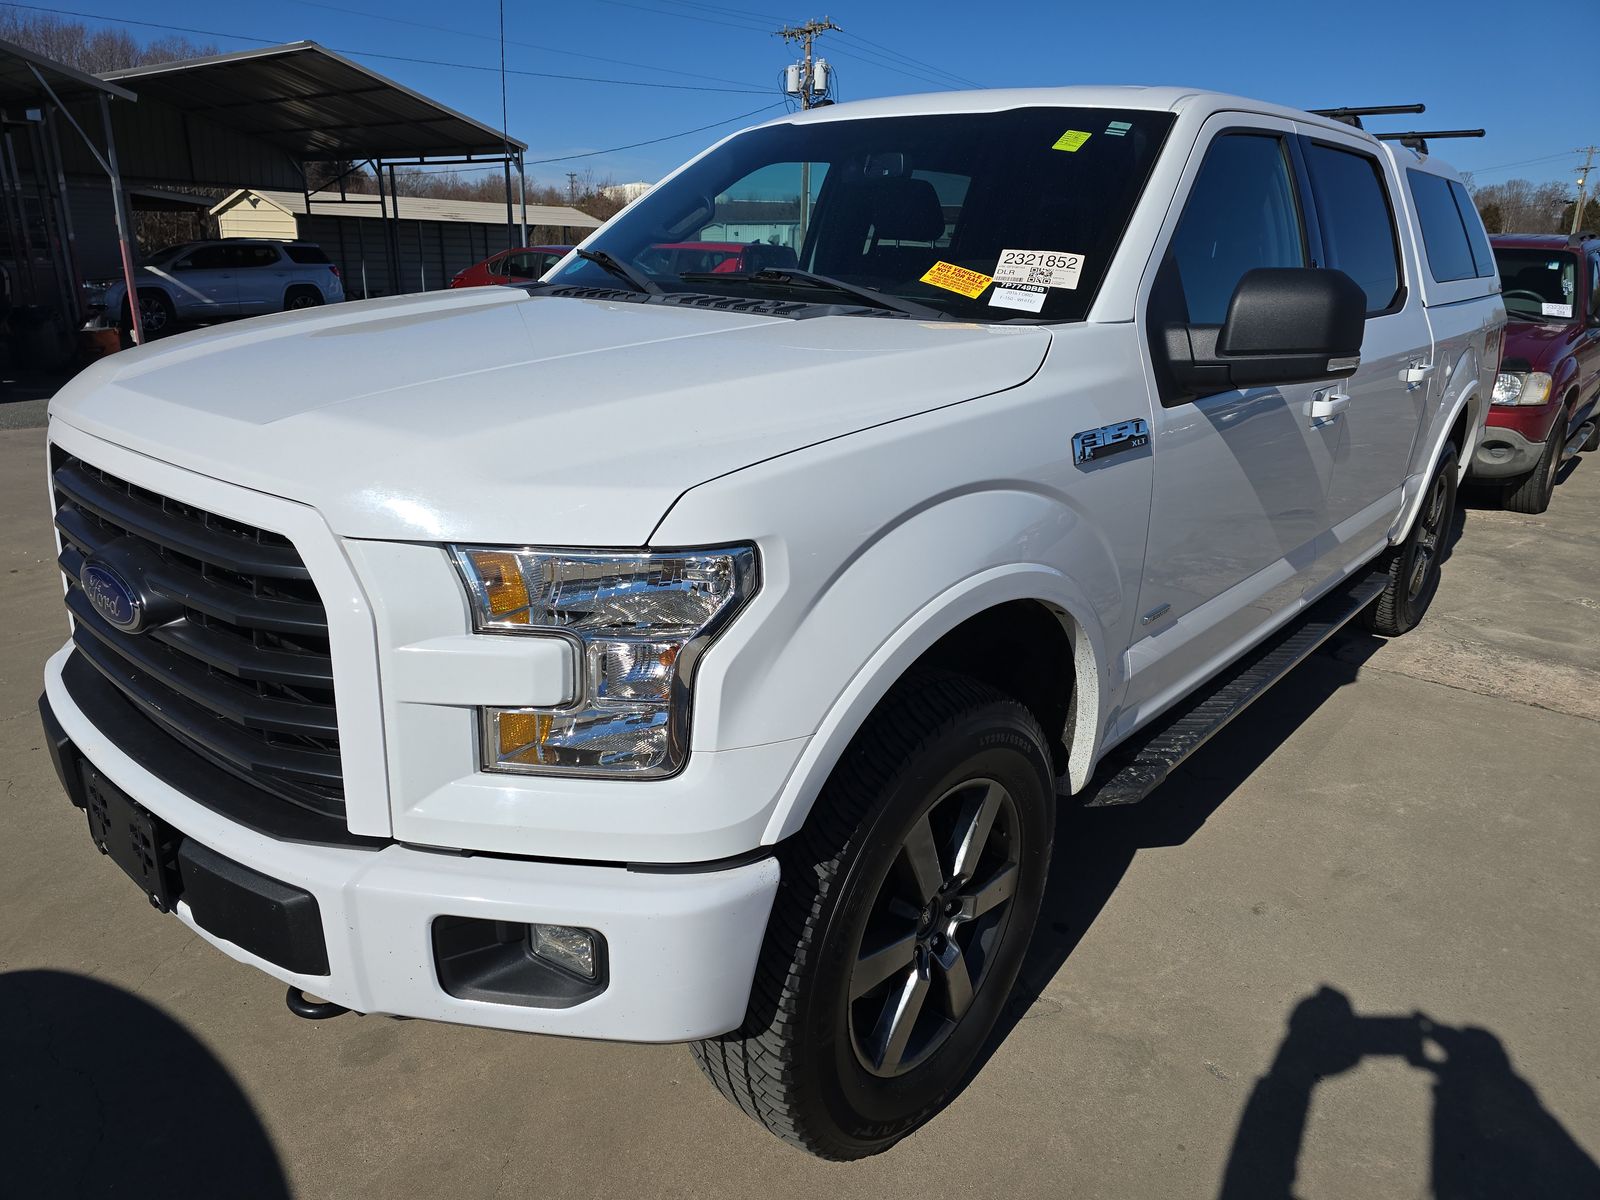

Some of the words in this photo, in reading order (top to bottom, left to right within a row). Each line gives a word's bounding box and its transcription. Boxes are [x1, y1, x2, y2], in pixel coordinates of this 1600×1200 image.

[1004, 252, 1078, 270] 2321852
[938, 262, 952, 270] THIS
[954, 267, 983, 279] VEHICLE
[950, 271, 965, 279] FOR
[966, 276, 984, 285] SALE
[1000, 282, 1045, 293] 7P7749BB
[1131, 438, 1146, 447] XLT
[86, 574, 121, 616] Ford
